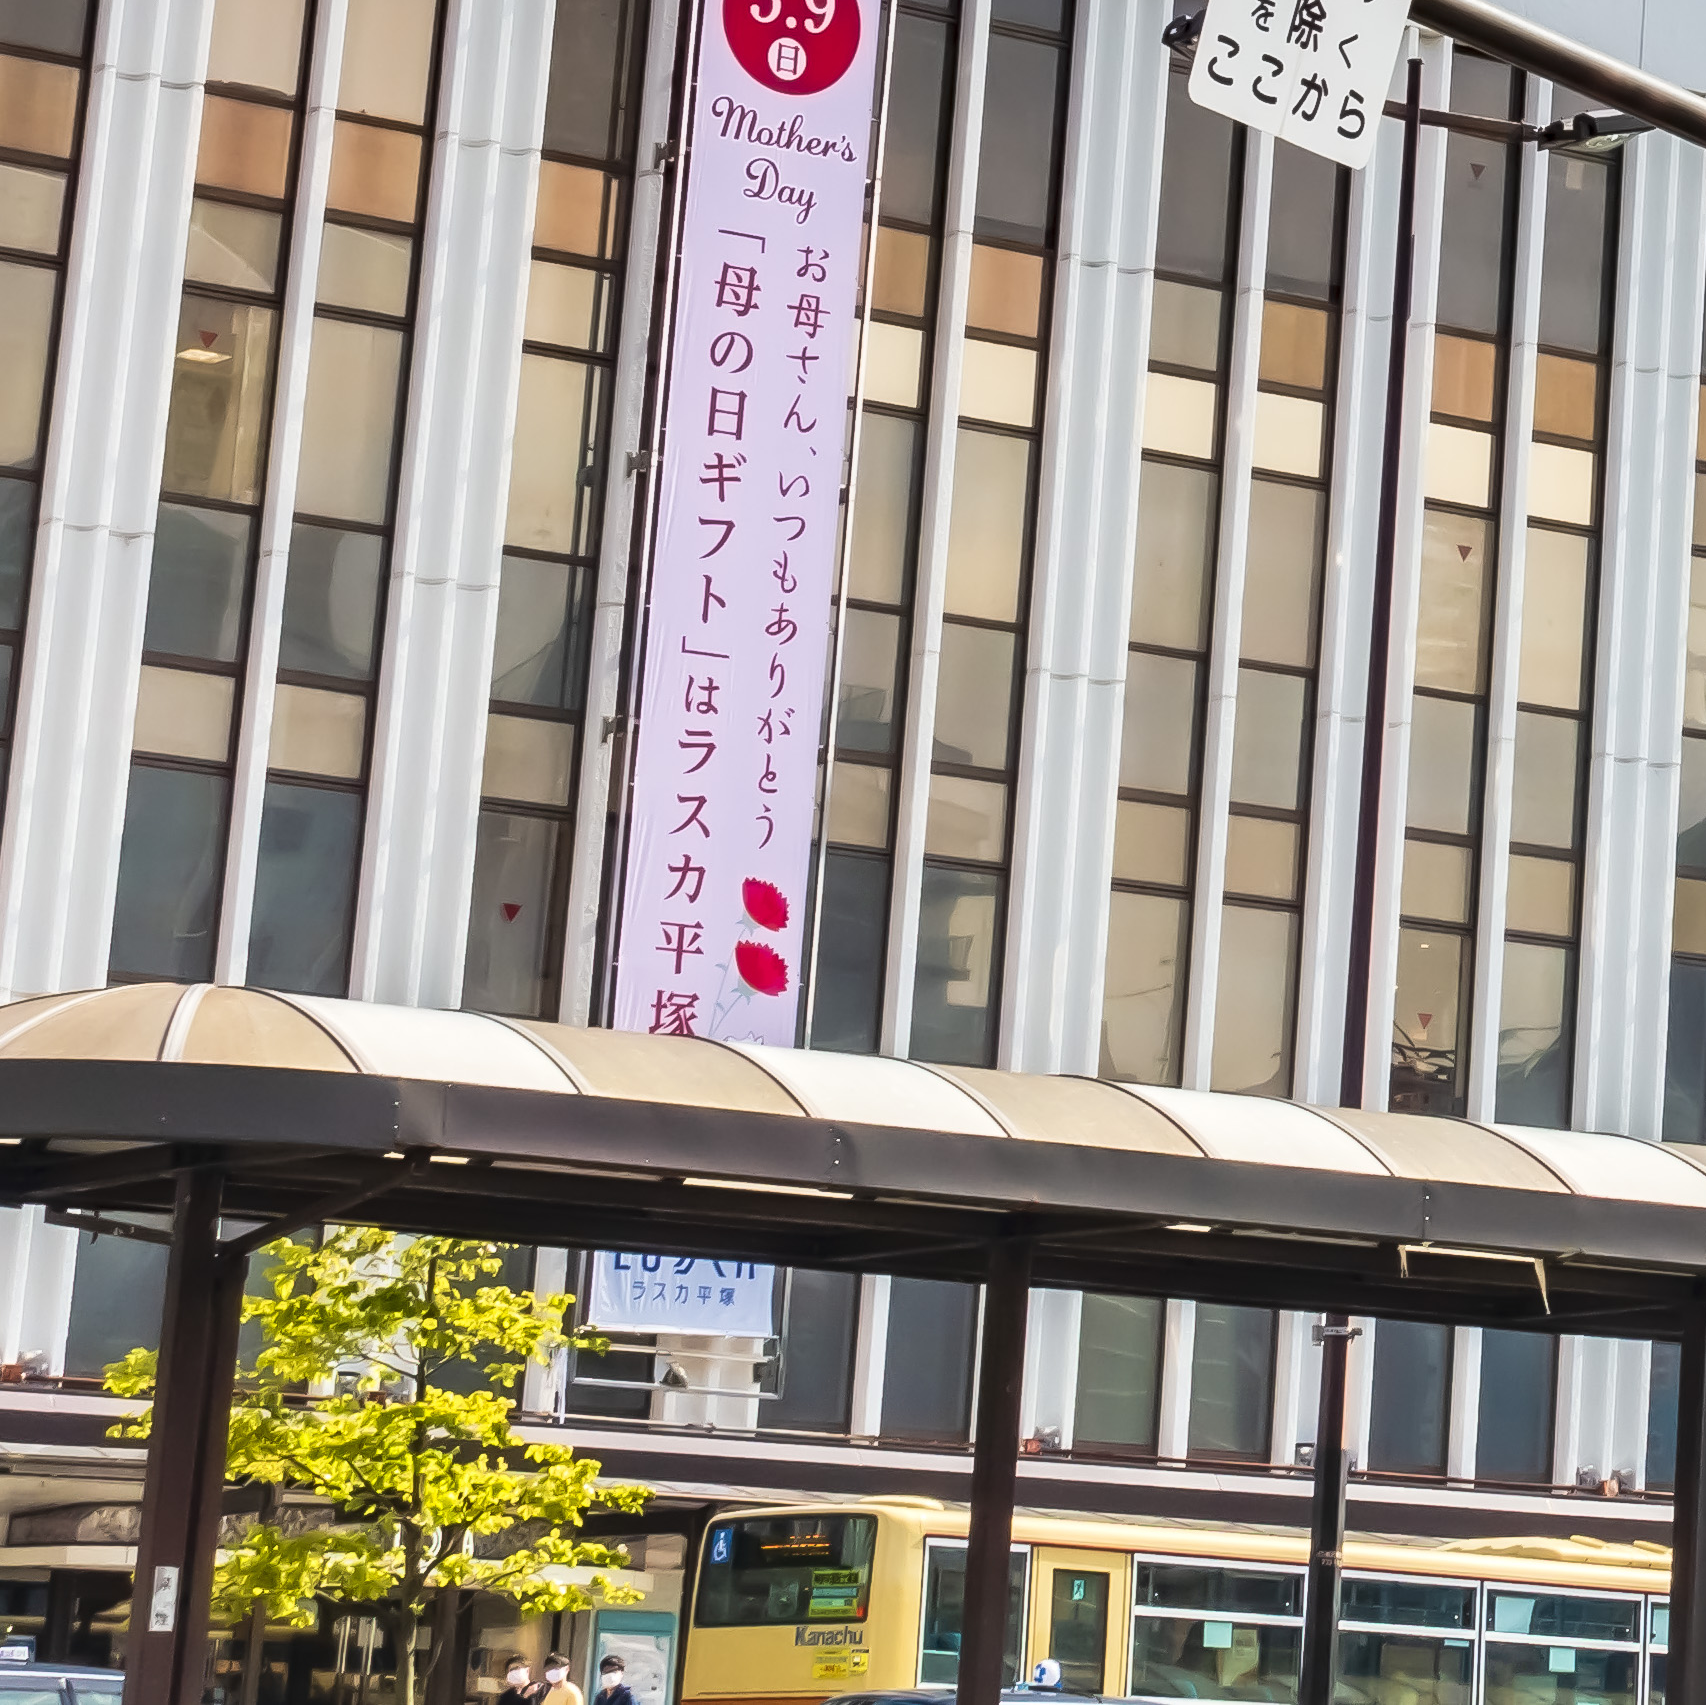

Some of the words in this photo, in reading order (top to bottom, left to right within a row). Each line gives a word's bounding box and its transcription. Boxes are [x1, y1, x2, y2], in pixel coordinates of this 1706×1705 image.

[775, 43, 800, 75] 日
[1207, 34, 1366, 139] ここから
[711, 96, 857, 162] Mother's
[743, 158, 817, 224] Day
[755, 243, 829, 850] お母さん、いつもありがとう
[632, 1280, 736, 1307] ラスカ平塚
[794, 1625, 864, 1647] Kanachu
